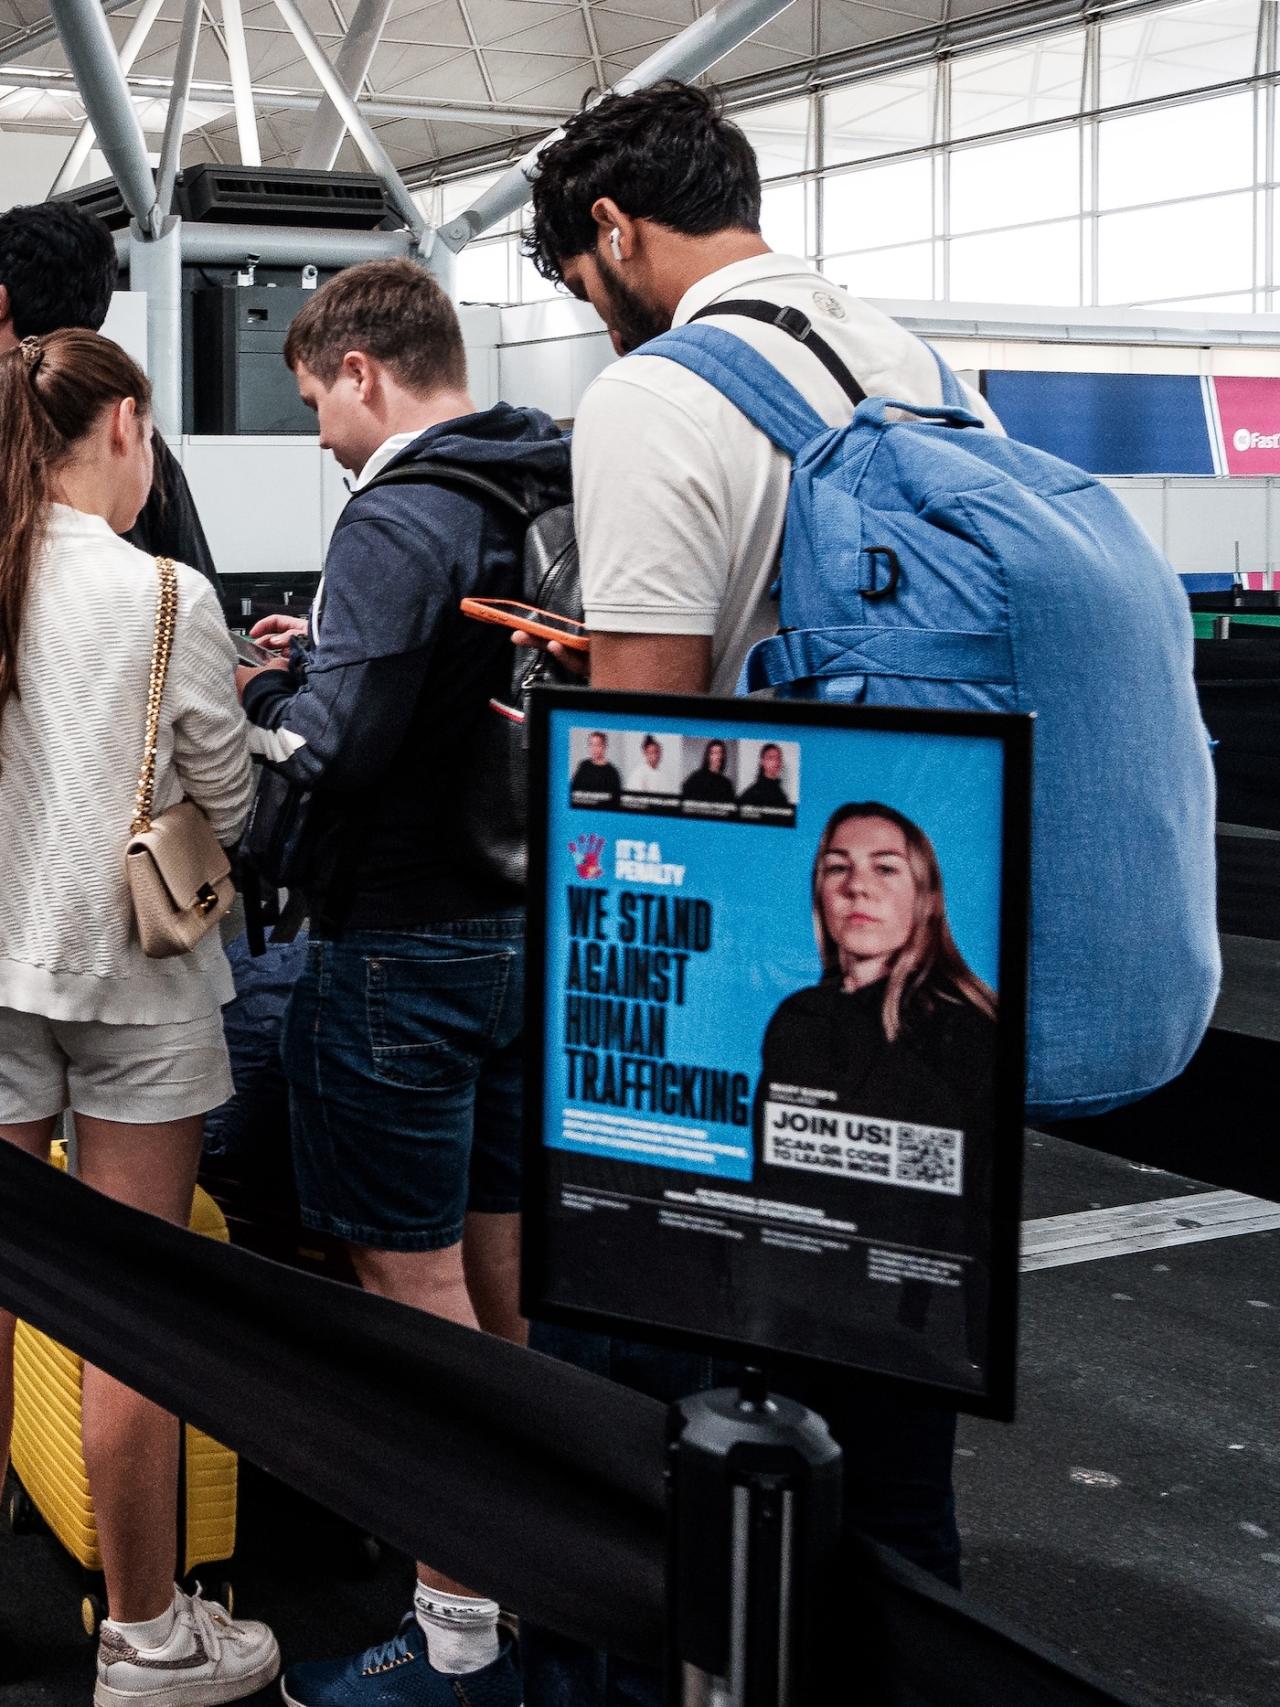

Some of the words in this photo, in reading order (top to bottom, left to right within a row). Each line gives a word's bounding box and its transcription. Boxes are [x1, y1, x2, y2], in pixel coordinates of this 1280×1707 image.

[567, 885, 609, 940] WE
[618, 891, 713, 953] STAND
[567, 939, 690, 1006] AGAINST
[566, 995, 666, 1058] HUMAN
[564, 1049, 750, 1127] TRAFFICKING
[773, 1111, 838, 1138] JOIN
[846, 1121, 892, 1147] US!
[846, 1147, 890, 1164] CODE
[773, 1148, 792, 1161] TO
[794, 1151, 843, 1169] LEARN
[847, 1161, 890, 1177] MORE
